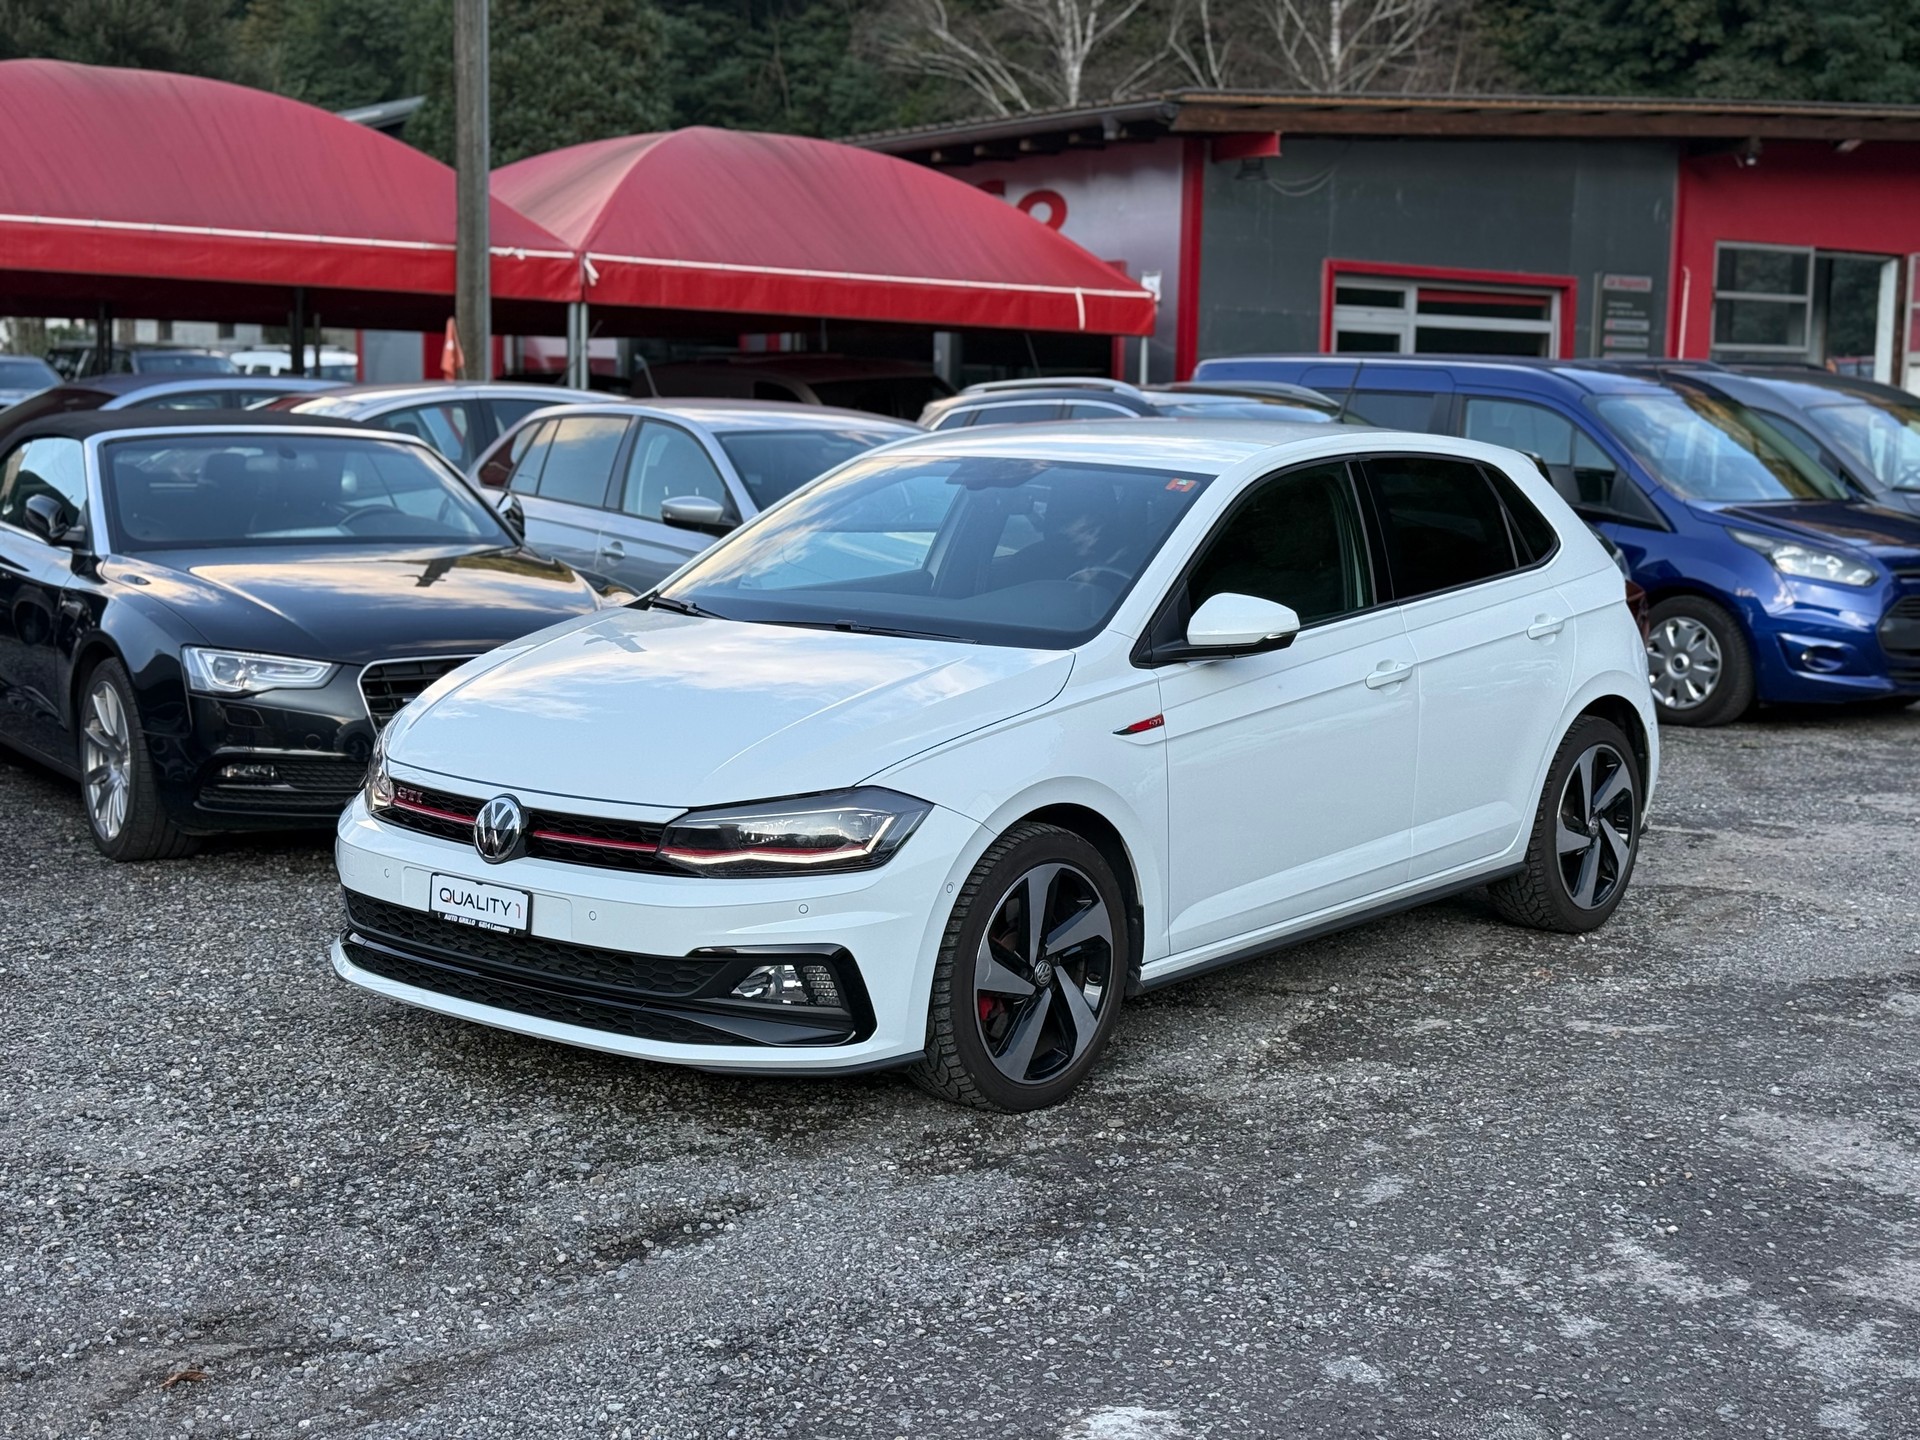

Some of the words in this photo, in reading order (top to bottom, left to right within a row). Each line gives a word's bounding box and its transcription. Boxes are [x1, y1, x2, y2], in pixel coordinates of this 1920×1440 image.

[397, 786, 423, 804] GTI
[439, 887, 512, 916] QUALITY
[443, 913, 458, 922] AUTO
